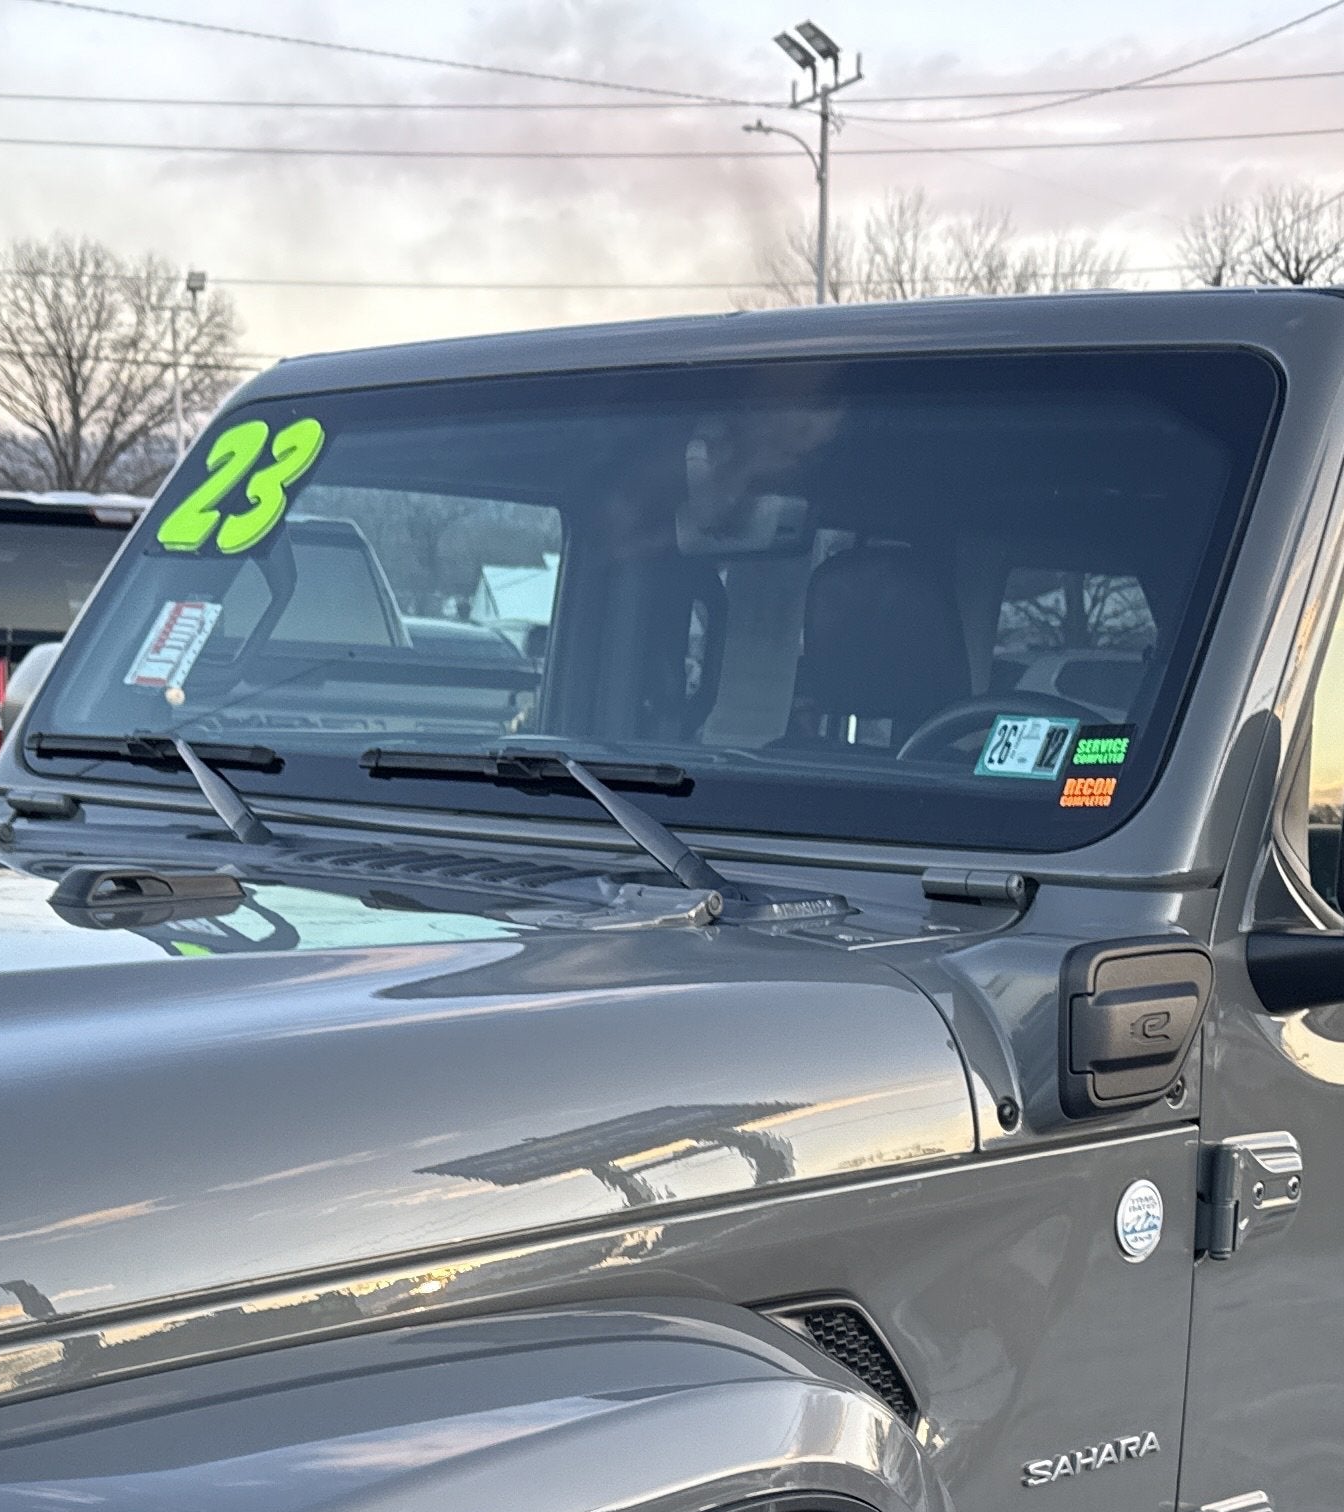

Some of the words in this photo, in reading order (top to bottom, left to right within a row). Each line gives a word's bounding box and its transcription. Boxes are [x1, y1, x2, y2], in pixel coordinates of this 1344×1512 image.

[157, 417, 325, 554] 23
[987, 724, 1018, 765] 26
[1076, 738, 1130, 753] SERVICE
[1063, 777, 1117, 795] RECON
[1020, 1431, 1161, 1488] SAHARA
